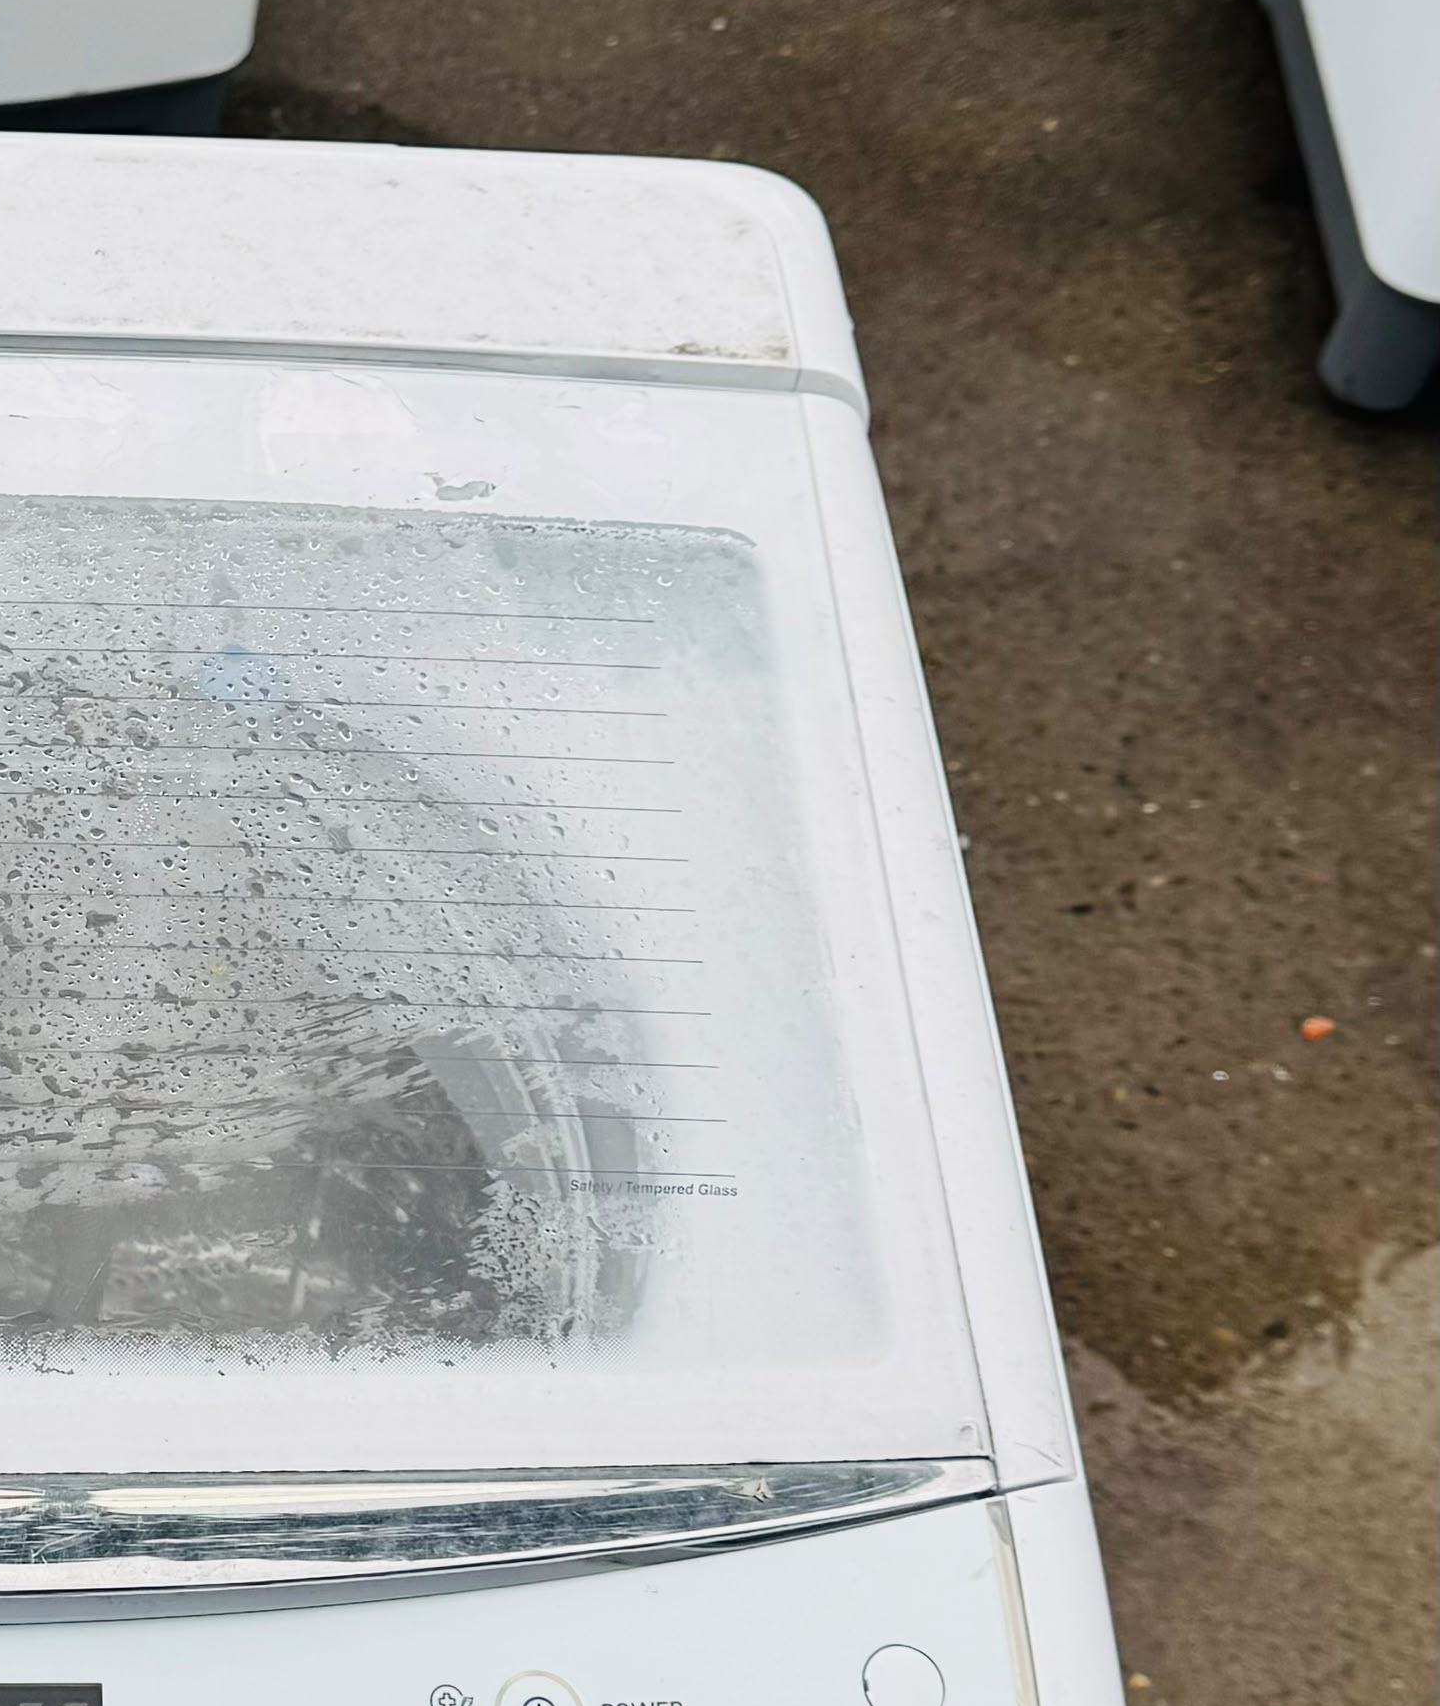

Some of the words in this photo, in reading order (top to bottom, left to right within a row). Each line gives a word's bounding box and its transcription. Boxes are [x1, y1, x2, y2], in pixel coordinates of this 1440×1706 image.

[570, 1179, 614, 1193] Safety
[626, 1180, 694, 1196] Tempered
[698, 1183, 738, 1197] Glass
